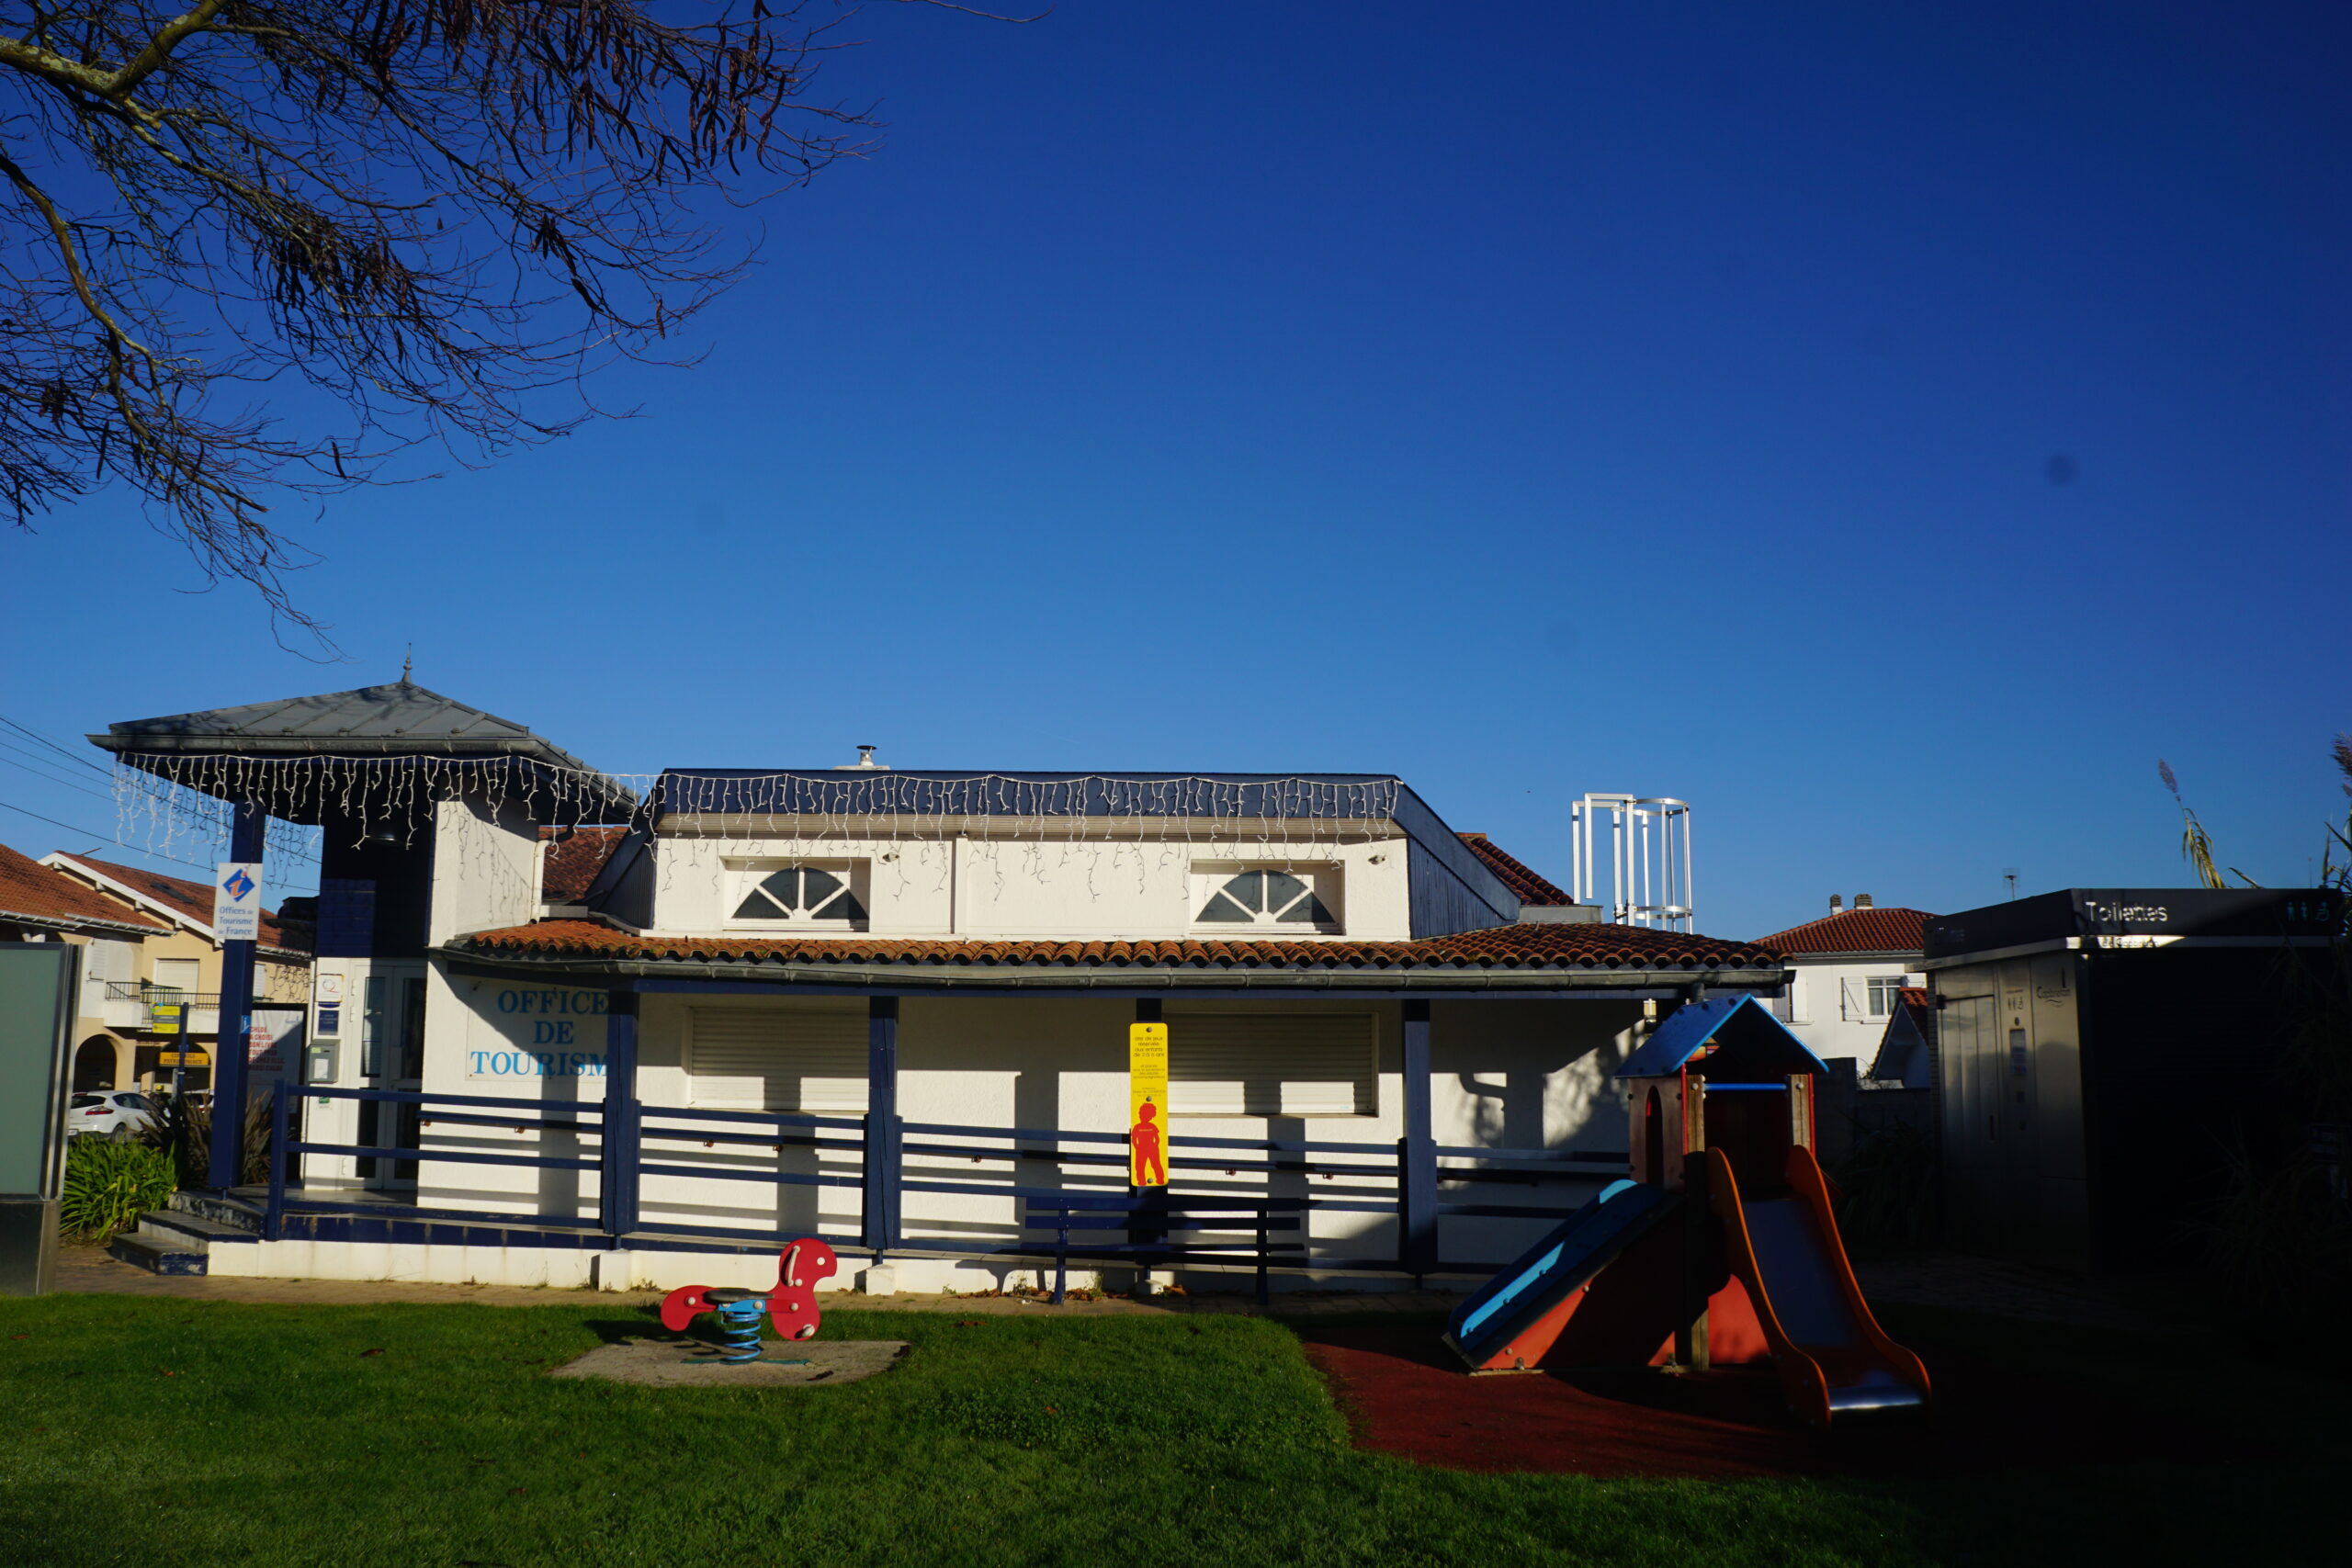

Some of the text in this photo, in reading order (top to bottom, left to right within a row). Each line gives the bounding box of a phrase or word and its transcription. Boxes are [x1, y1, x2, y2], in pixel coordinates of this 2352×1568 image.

[219, 906, 246, 915] Offices
[219, 916, 253, 925] Tourisme
[2085, 901, 2168, 922] Toilettes
[226, 926, 253, 936] France
[497, 989, 609, 1015] OFFICE
[533, 1021, 574, 1044] DE
[470, 1051, 607, 1077] TOURISM
